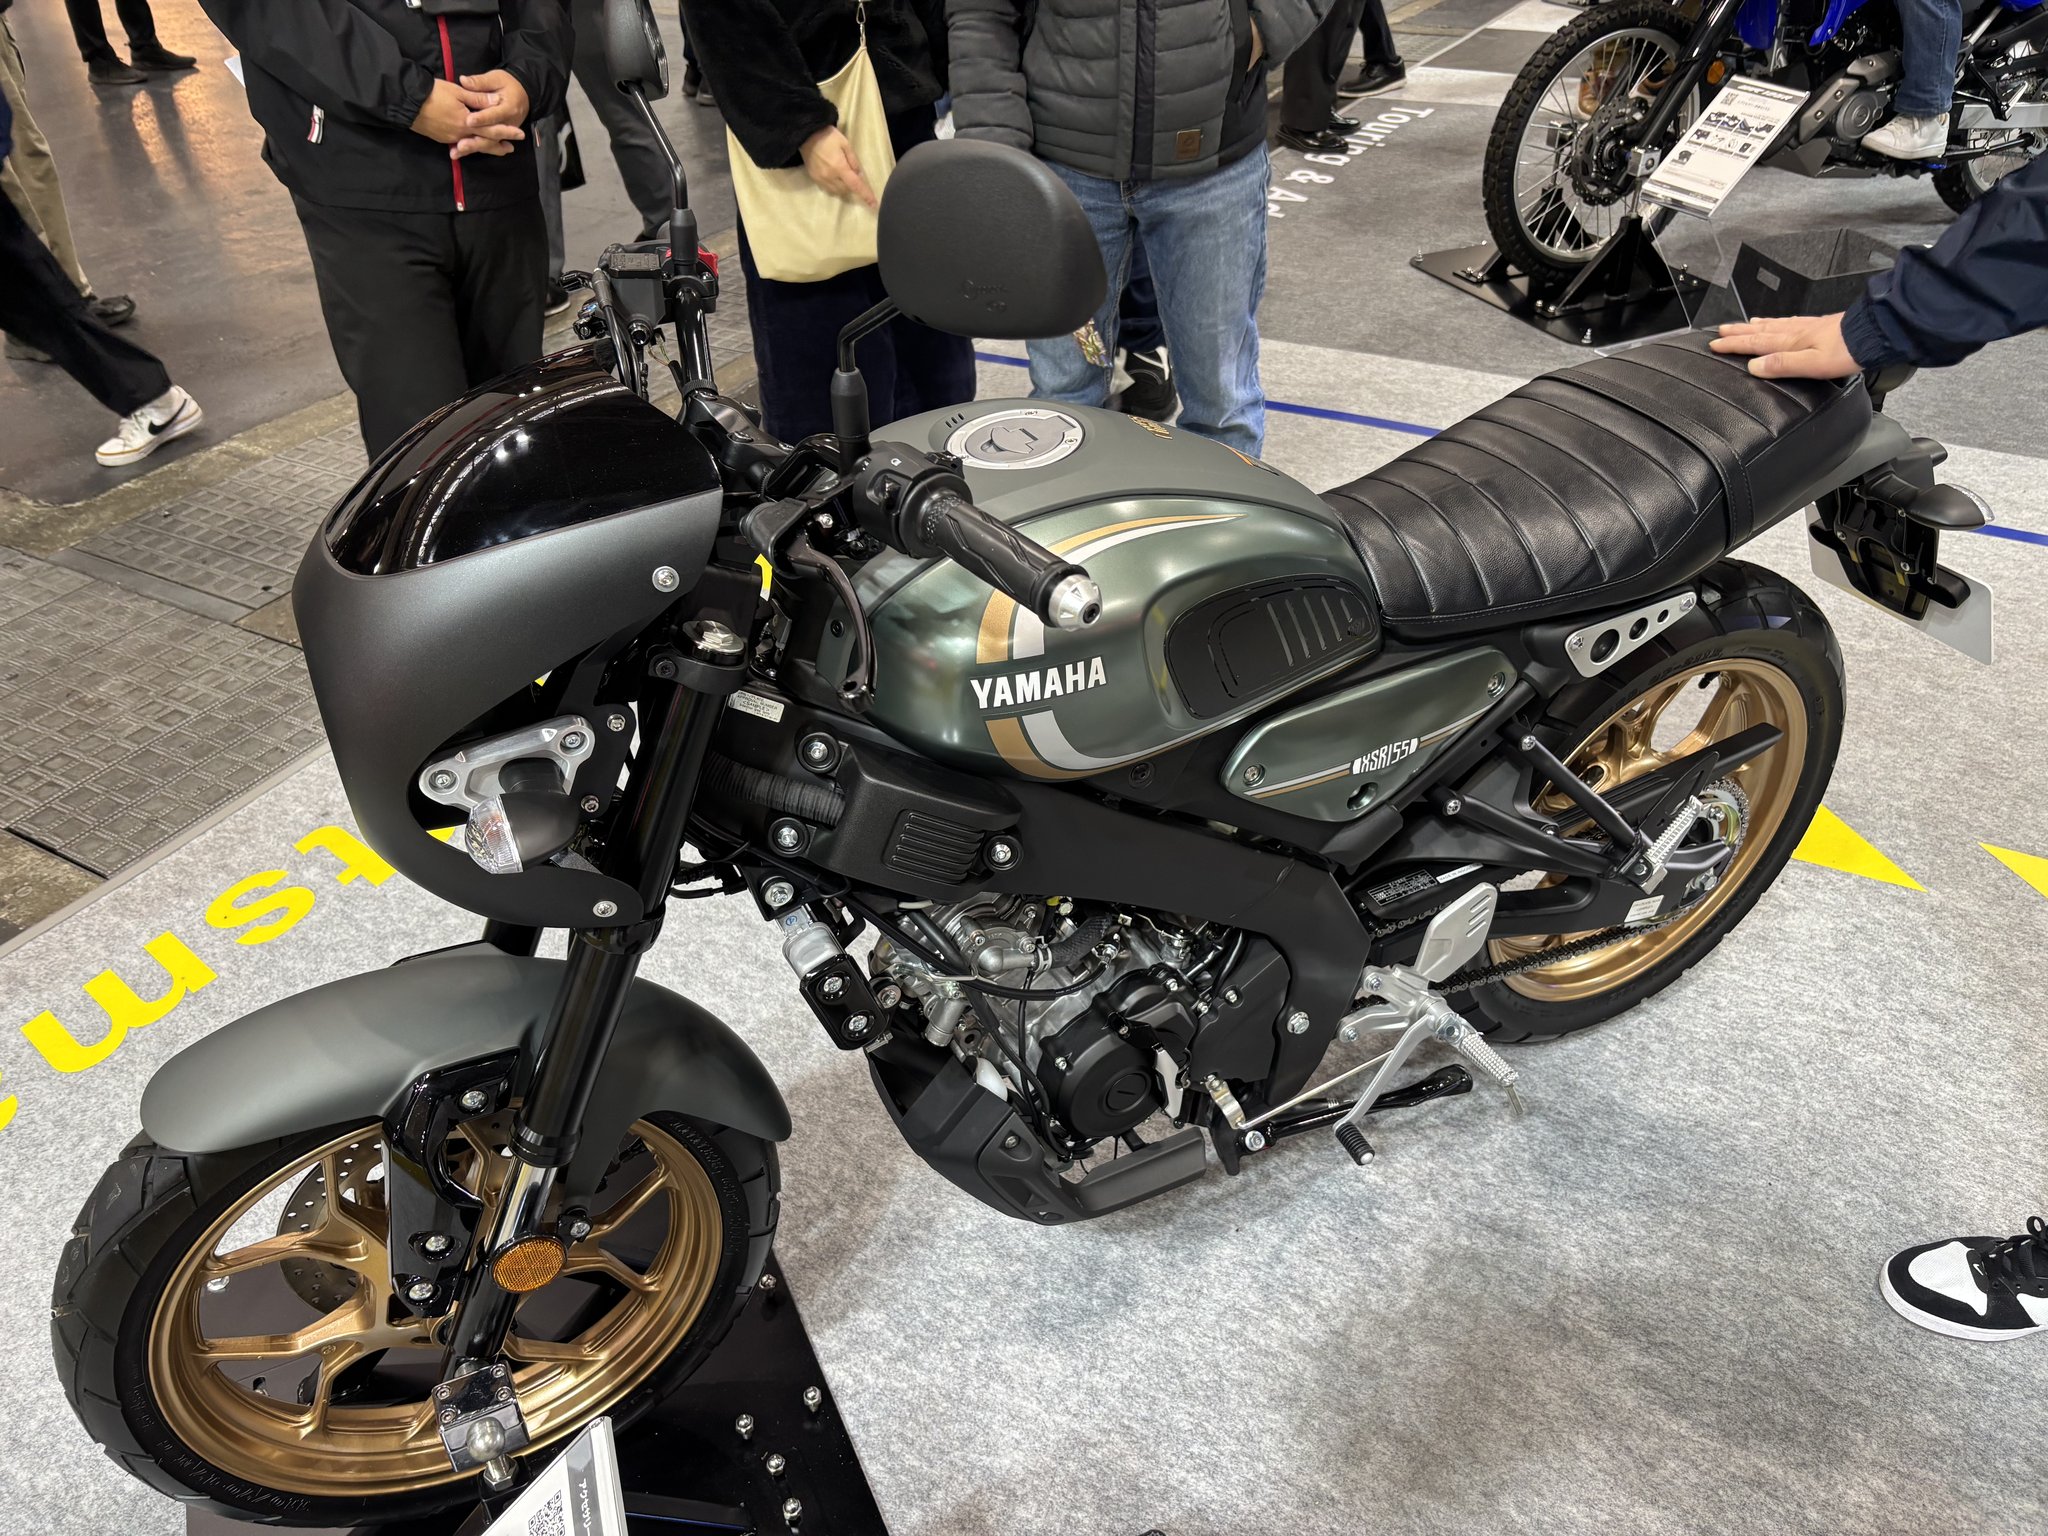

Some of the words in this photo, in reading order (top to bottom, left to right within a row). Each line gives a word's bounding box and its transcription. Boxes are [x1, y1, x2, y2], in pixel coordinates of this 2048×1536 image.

[1304, 107, 1435, 167] Touring
[1283, 169, 1335, 184] &
[970, 656, 1107, 709] YAMAHA
[1361, 739, 1410, 773] XSR155
